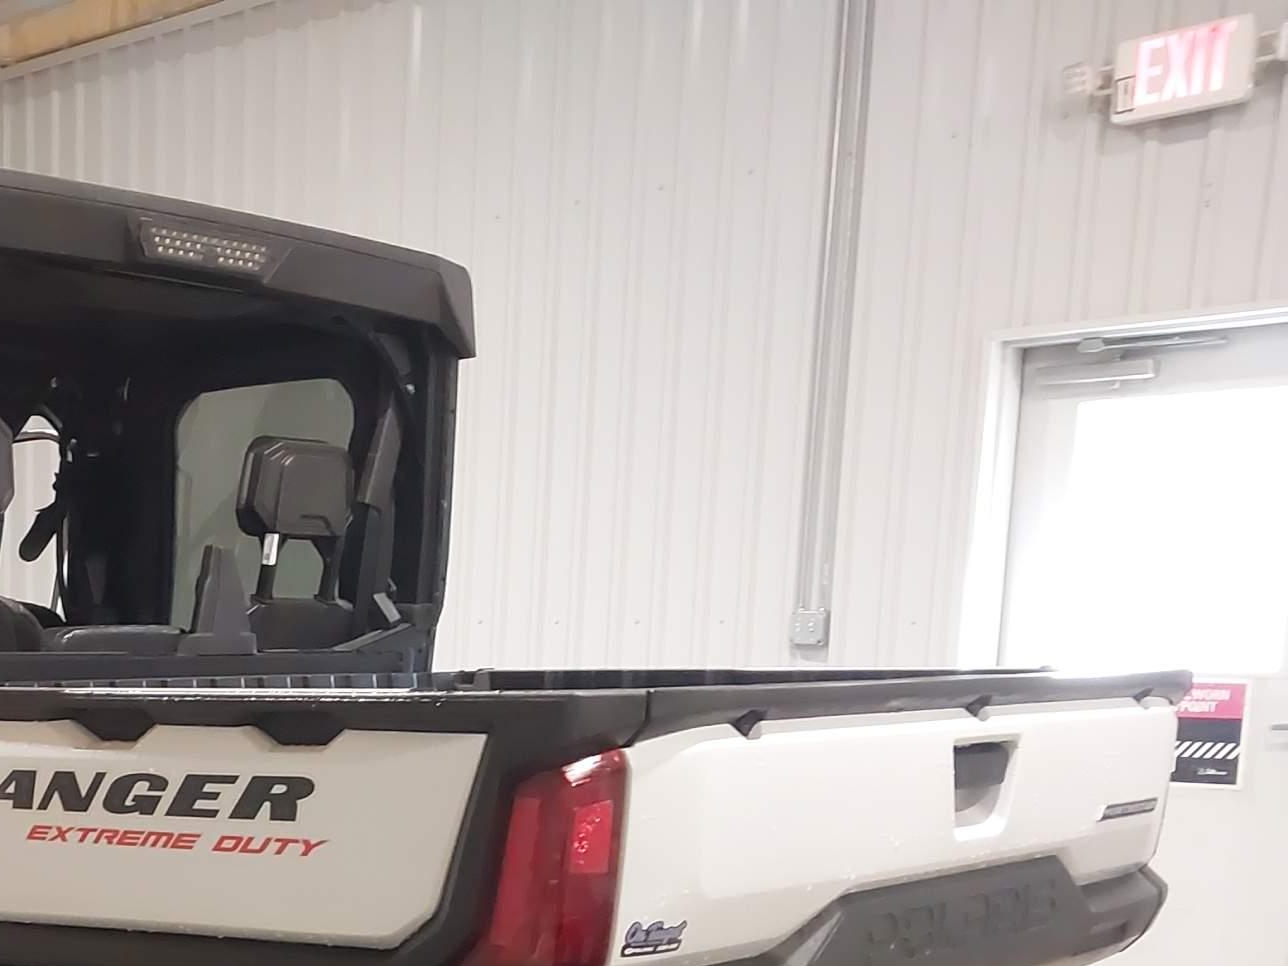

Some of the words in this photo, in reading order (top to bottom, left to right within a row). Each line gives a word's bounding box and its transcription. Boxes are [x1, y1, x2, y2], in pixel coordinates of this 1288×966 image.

[1133, 18, 1240, 106] EXIT
[26, 824, 202, 850] EXTREME
[212, 834, 330, 857] DUTY
